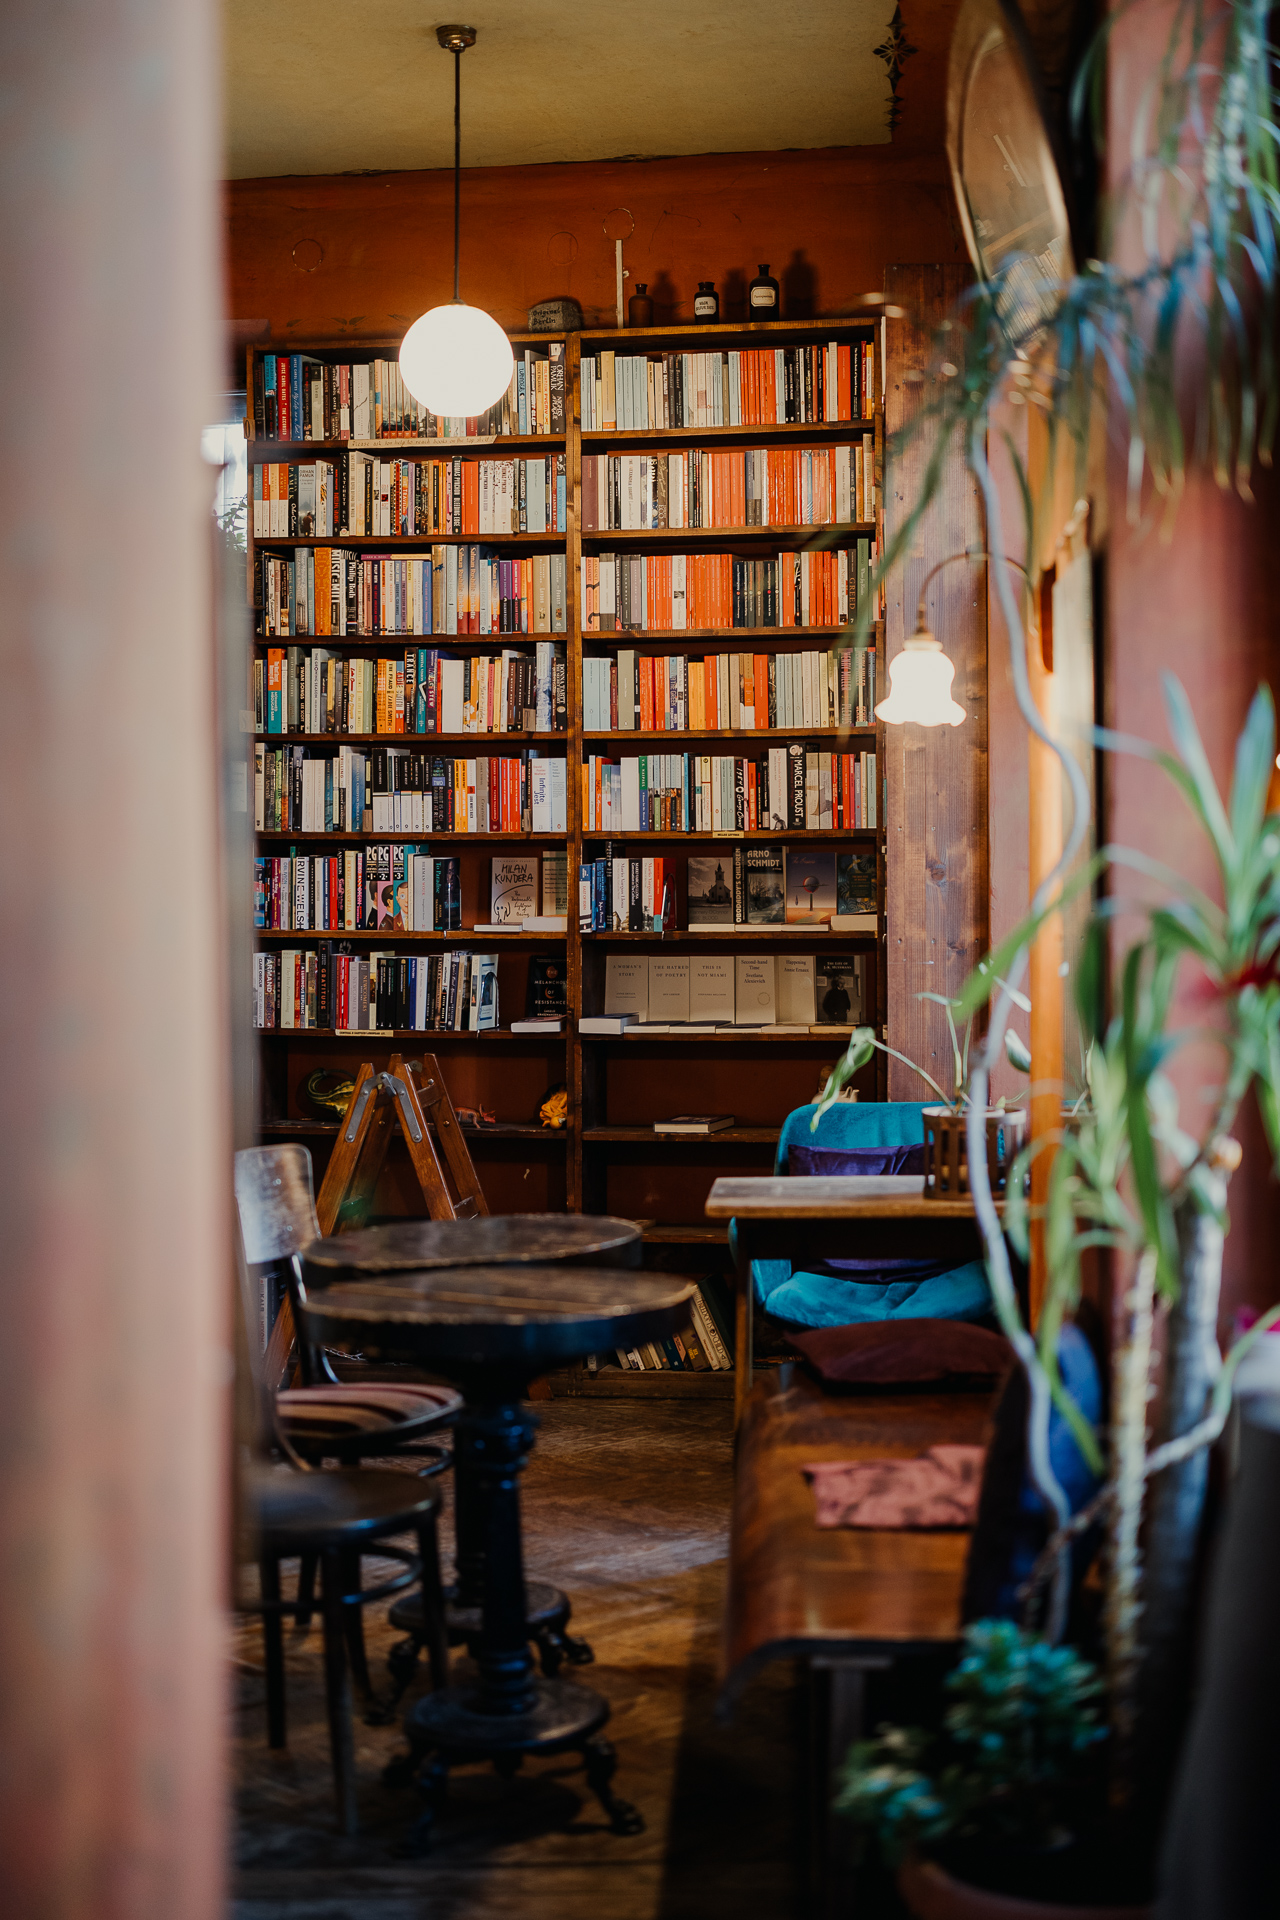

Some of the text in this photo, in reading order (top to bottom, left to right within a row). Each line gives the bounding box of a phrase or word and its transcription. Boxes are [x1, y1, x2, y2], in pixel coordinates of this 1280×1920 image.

[348, 562, 356, 598] Philip Roth
[794, 760, 803, 817] MARCEL PROUST
[747, 850, 770, 858] ARNO
[747, 859, 780, 867] SCHMIDT
[502, 864, 527, 873] MILAN
[494, 872, 534, 884] KUNDERA
